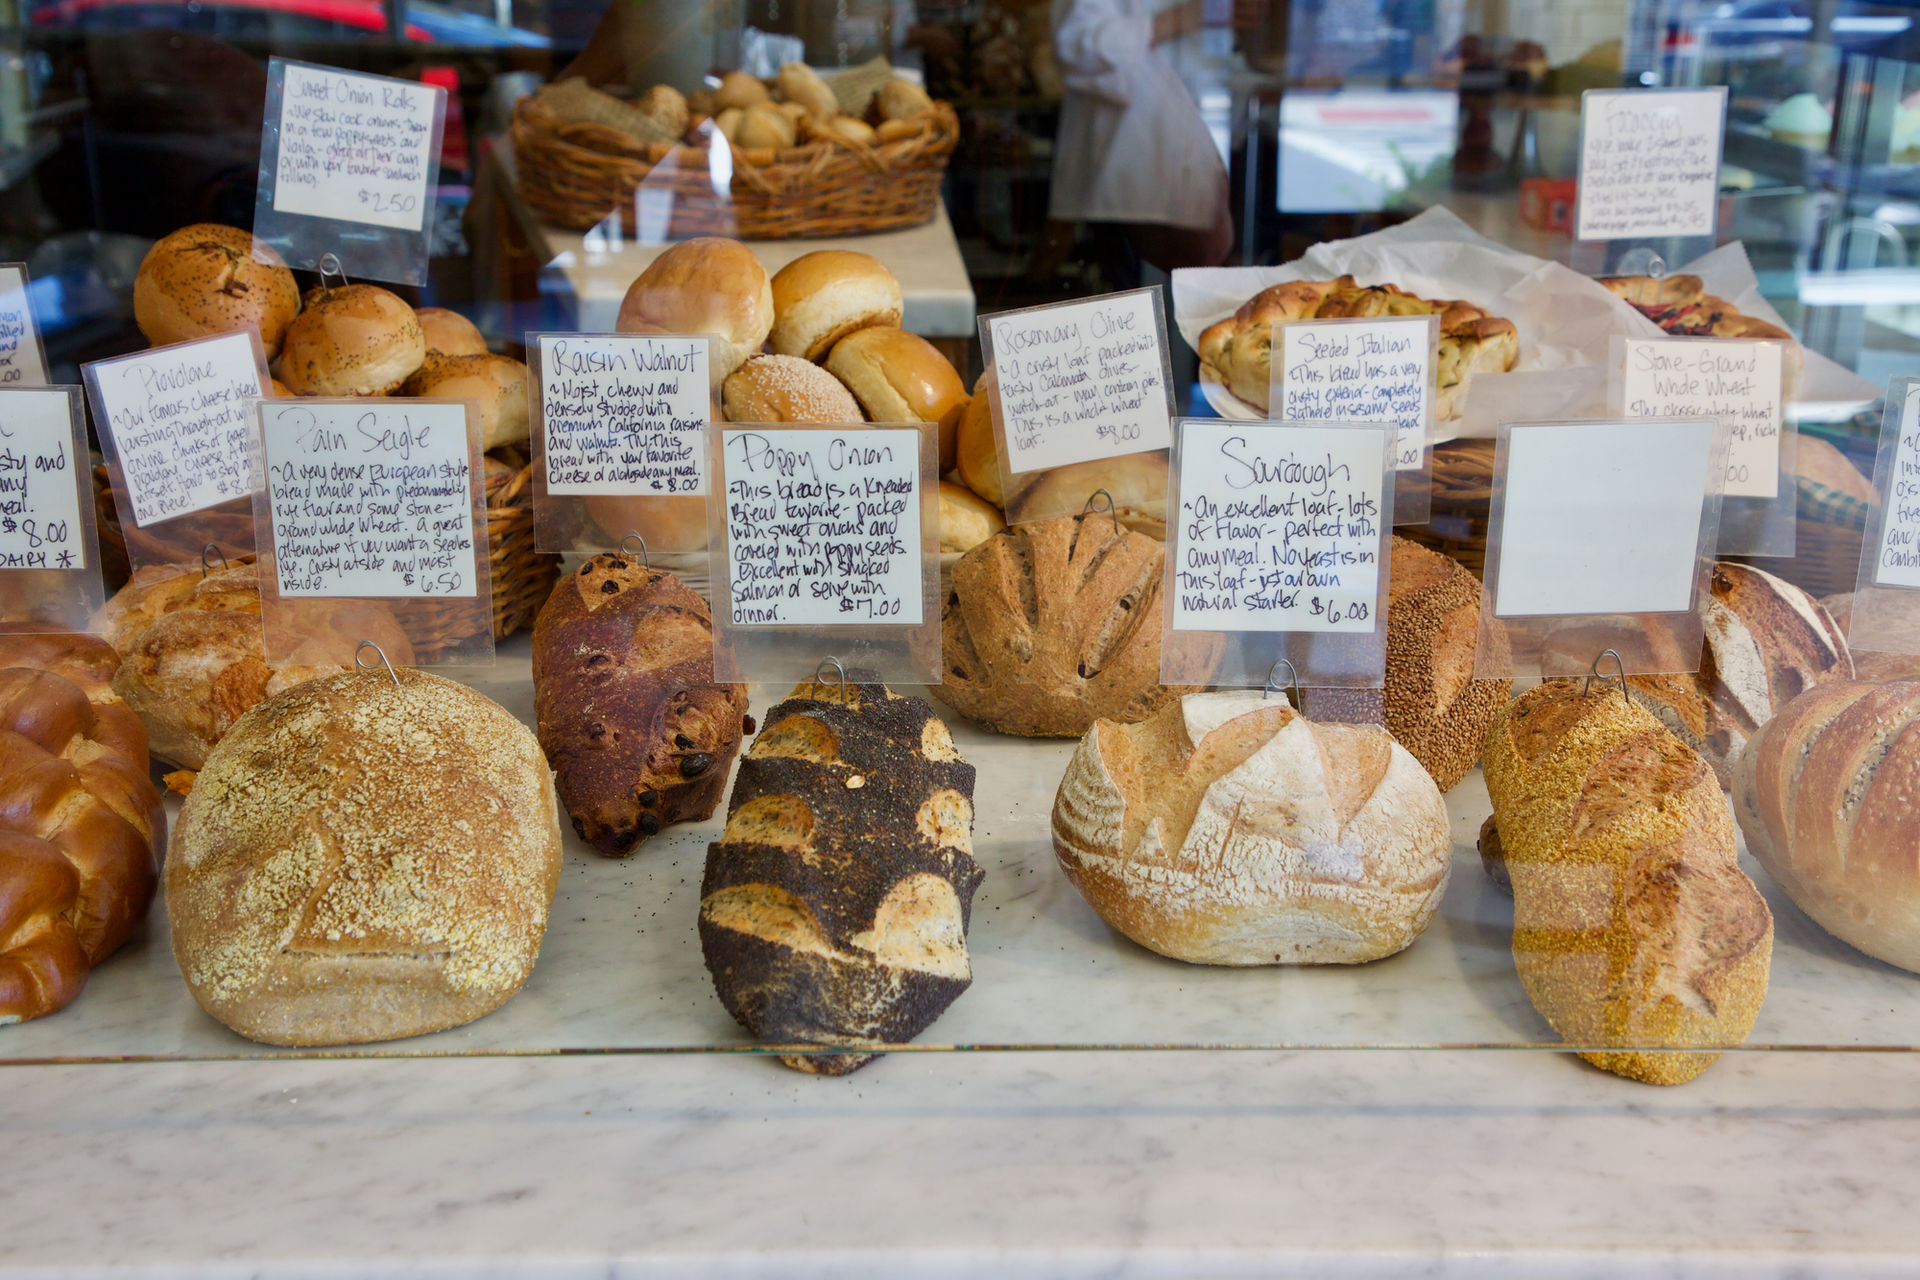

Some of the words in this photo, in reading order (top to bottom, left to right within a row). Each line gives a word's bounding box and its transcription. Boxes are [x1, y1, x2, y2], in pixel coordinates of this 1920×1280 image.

[336, 79, 373, 105] Onion
[996, 322, 1082, 355] Rosemary
[1091, 308, 1135, 338] Olive
[552, 340, 626, 376] Raisin
[632, 340, 702, 372] Walnut
[1298, 333, 1349, 363] Seeded
[1356, 333, 1411, 358] Italian
[1390, 368, 1398, 376] a
[658, 377, 678, 394] and
[546, 398, 593, 418] densely
[1391, 400, 1421, 414] seeds
[549, 419, 602, 435] premium
[608, 416, 665, 433] California
[1063, 412, 1072, 424] a
[278, 407, 346, 453] Pain
[357, 412, 430, 460] Seigle
[1755, 425, 1776, 436] rich
[549, 433, 572, 450] and
[36, 441, 65, 470] and
[549, 451, 584, 469] bread
[588, 450, 614, 465] with
[728, 433, 818, 480] Poppy
[828, 439, 892, 470] Onion
[331, 463, 365, 482] dense
[652, 467, 671, 480] any
[1221, 437, 1350, 496] Sourdough
[316, 483, 353, 498] made
[826, 483, 844, 499] is
[850, 484, 861, 497] a
[857, 500, 906, 521] packed
[1225, 492, 1300, 519] excellent
[1349, 492, 1377, 516] lots
[731, 523, 767, 539] with
[870, 518, 897, 535] and
[1188, 520, 1212, 541] of
[1285, 515, 1346, 544] perfect
[1348, 517, 1376, 537] with
[392, 550, 415, 573] and
[786, 539, 820, 558] with
[825, 542, 863, 564] poppy
[1188, 548, 1221, 569] any
[1272, 543, 1297, 566] No
[1343, 552, 1357, 564] is
[1359, 542, 1374, 563] in
[852, 576, 886, 595] with
